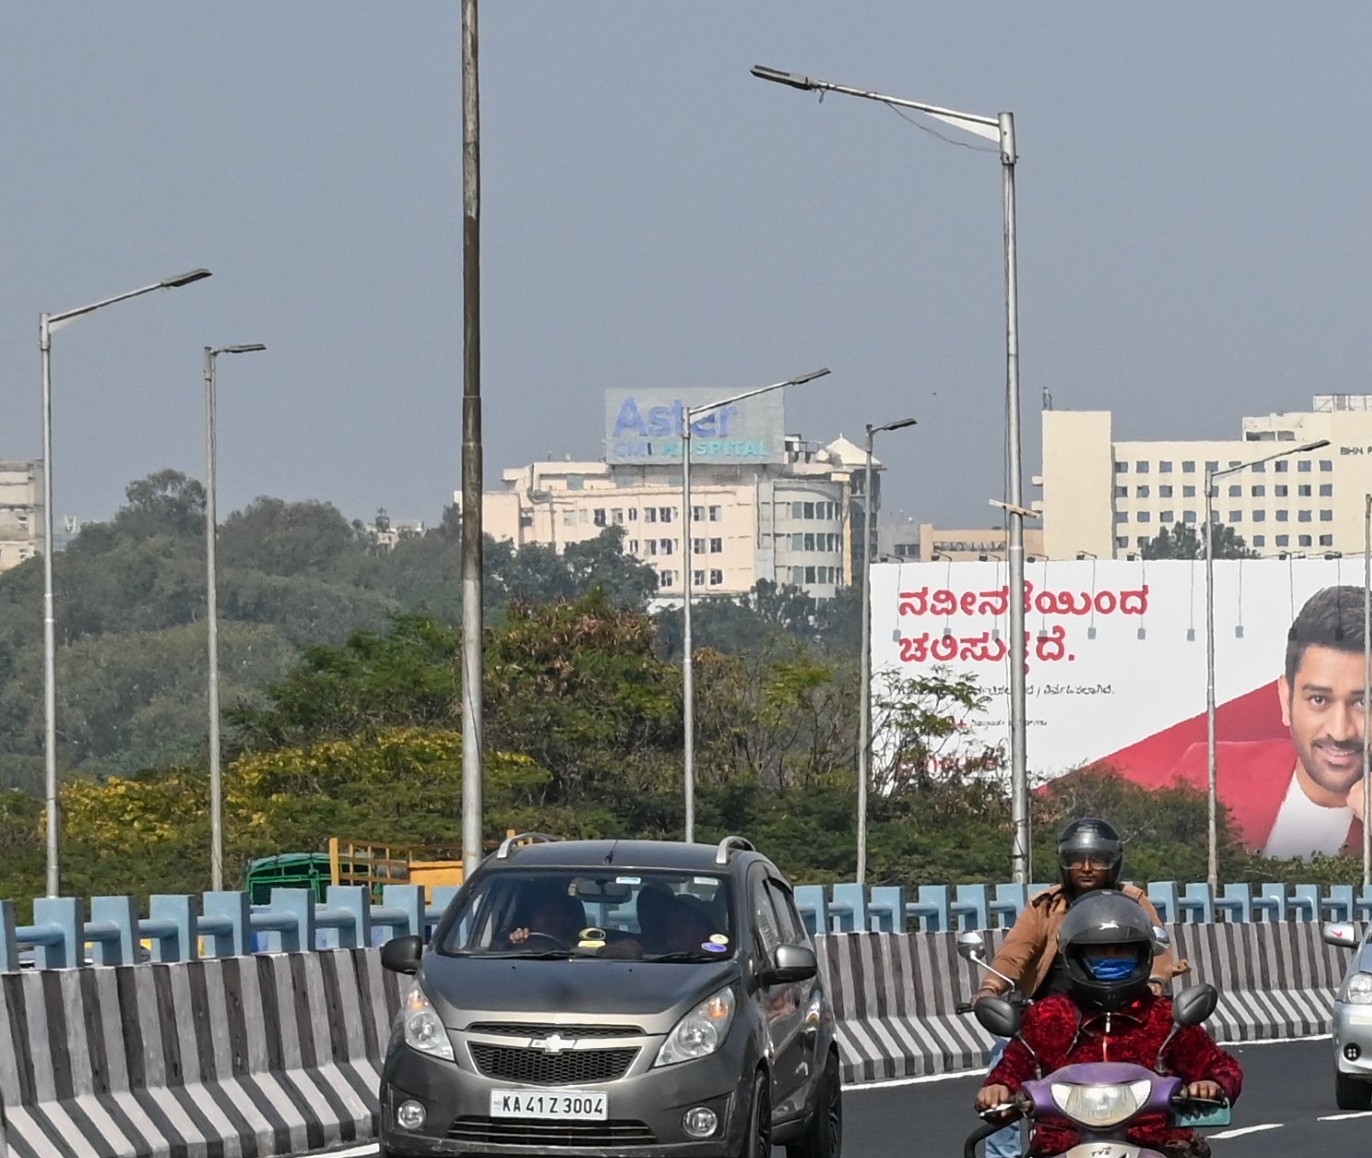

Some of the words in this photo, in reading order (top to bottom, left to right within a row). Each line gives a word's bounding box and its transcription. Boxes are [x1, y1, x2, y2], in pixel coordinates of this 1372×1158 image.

[661, 440, 769, 458] HSPITAL
[502, 1095, 521, 1112] KA
[526, 1096, 544, 1113] 41
[549, 1097, 558, 1114] Z
[563, 1098, 603, 1114] 3004
[1091, 1148, 1111, 1157] TVS
